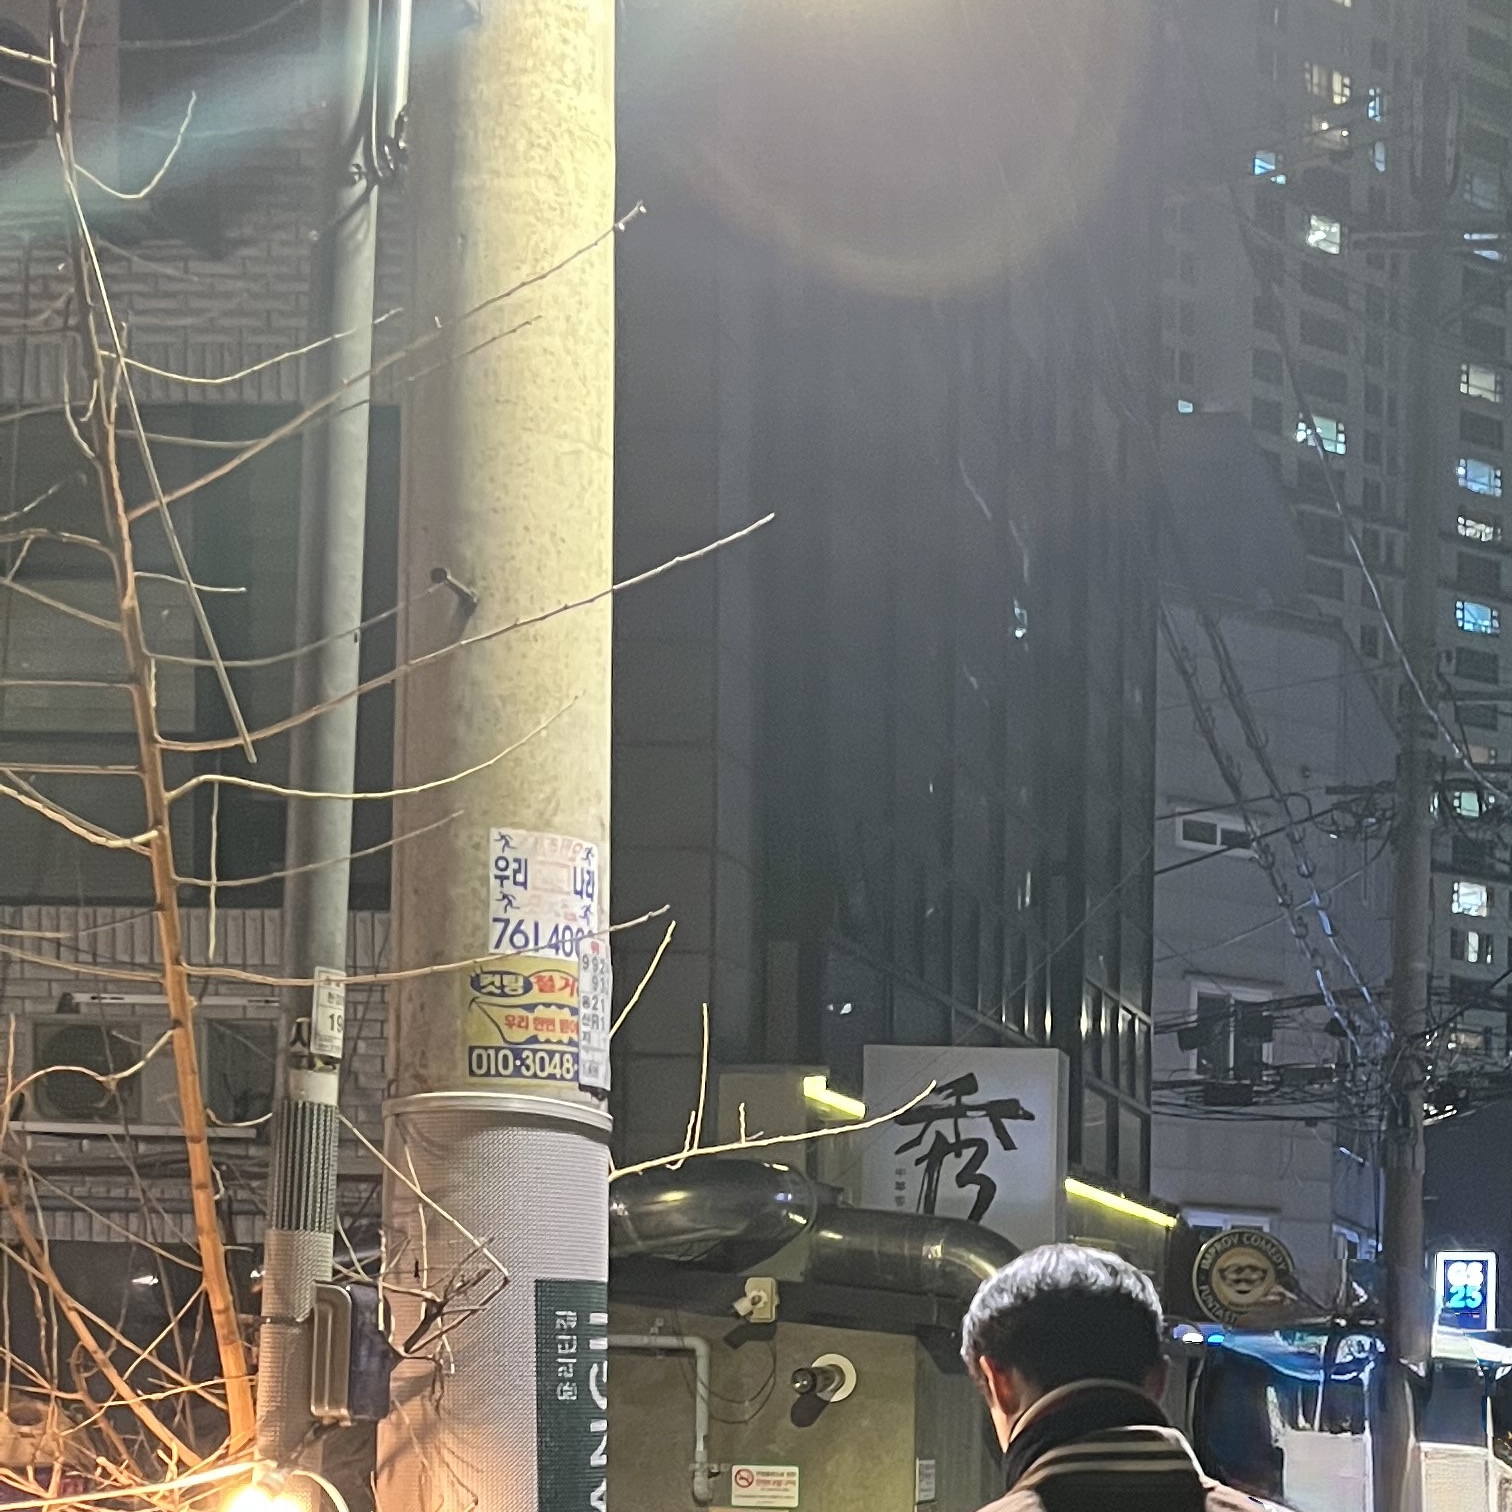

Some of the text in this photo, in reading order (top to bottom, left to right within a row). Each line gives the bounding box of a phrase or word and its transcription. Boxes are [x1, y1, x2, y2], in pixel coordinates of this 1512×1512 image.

[494, 855, 527, 890] 우리
[492, 917, 539, 953] 761
[1200, 1232, 1288, 1271] IMPROV COMEDY
[1447, 1261, 1484, 1287] GS
[1449, 1286, 1483, 1309] 25
